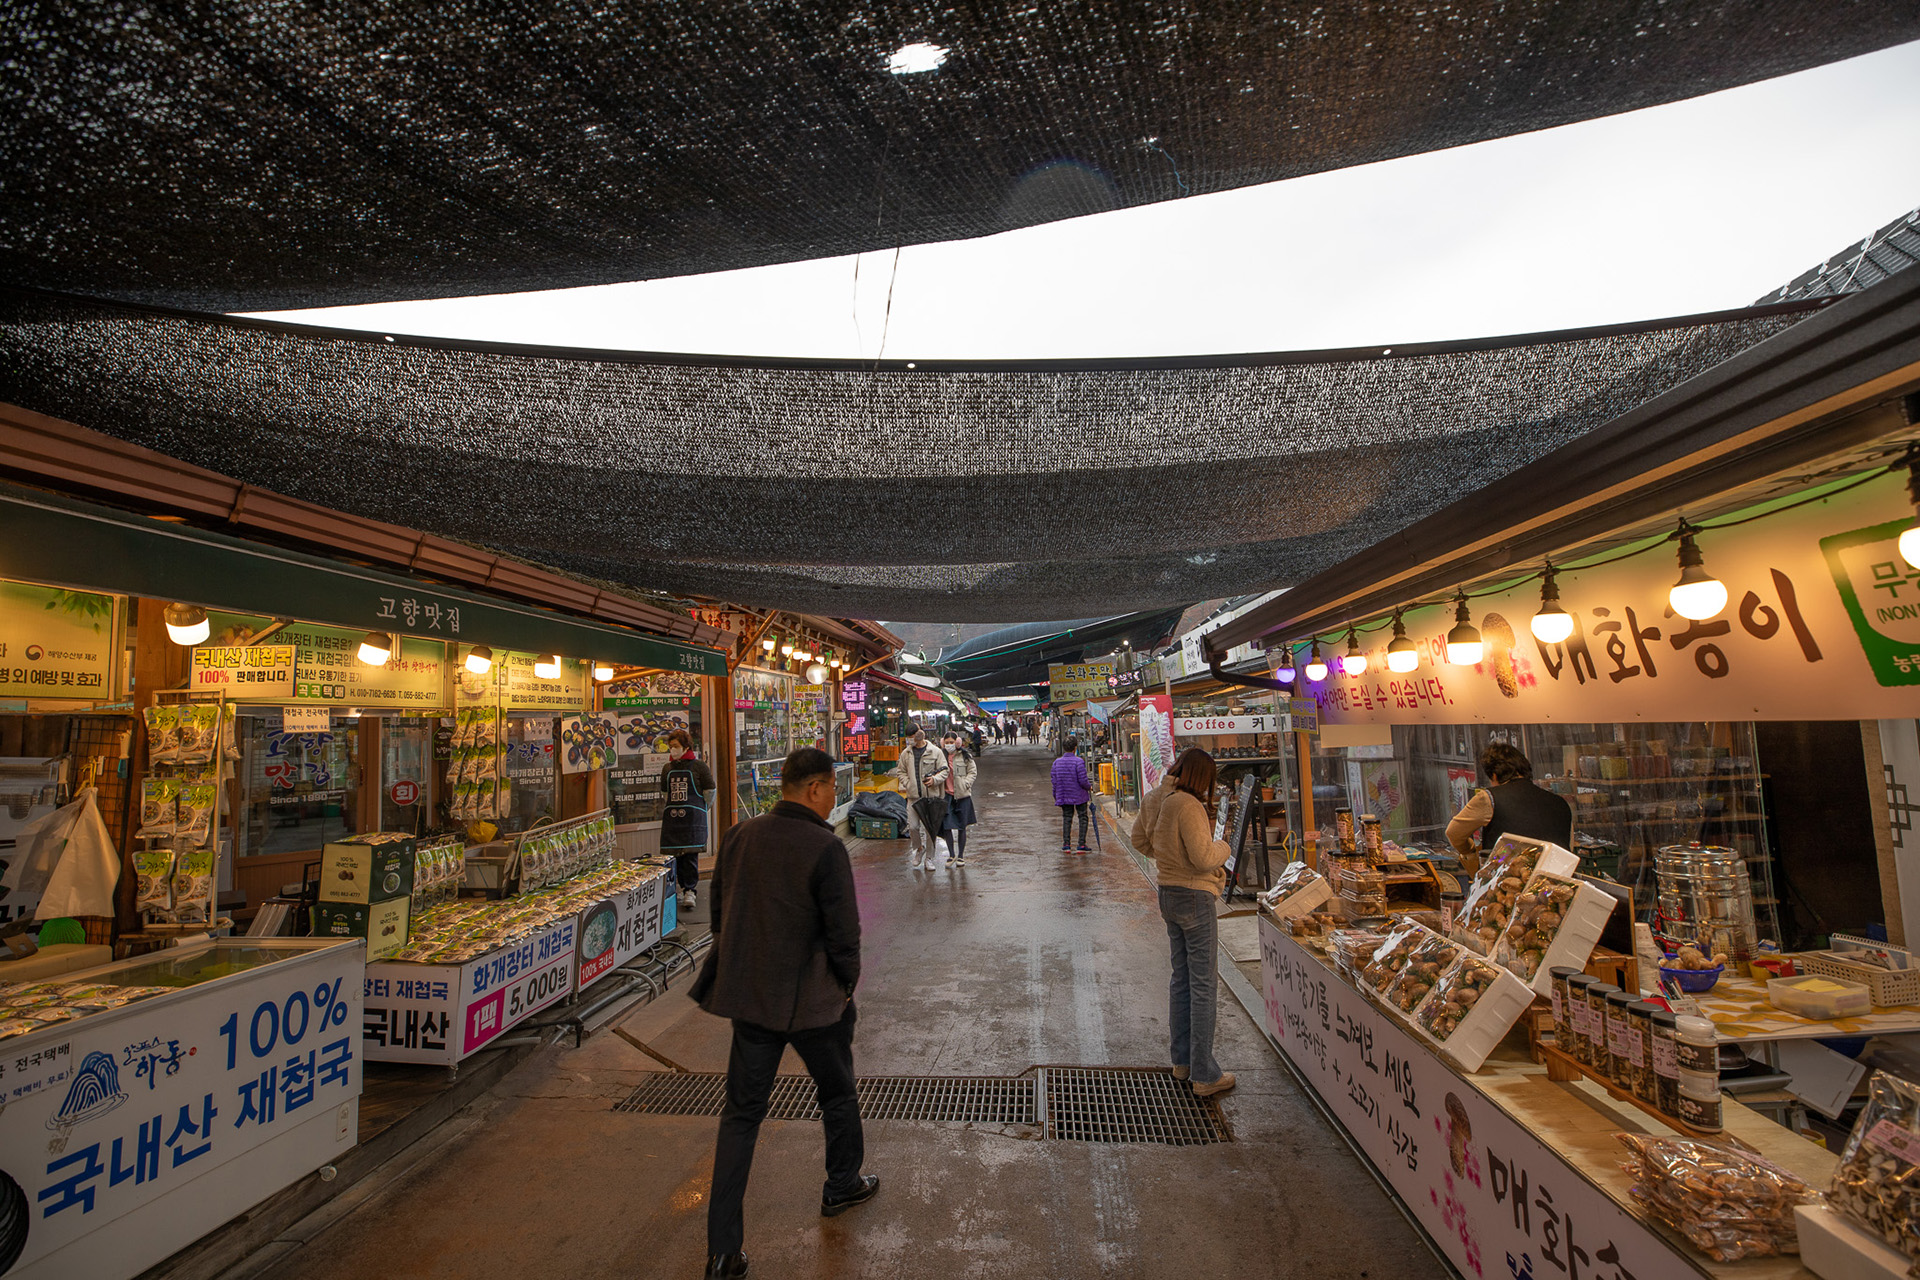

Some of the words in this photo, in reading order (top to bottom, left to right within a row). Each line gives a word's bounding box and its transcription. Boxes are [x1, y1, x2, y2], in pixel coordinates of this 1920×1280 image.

[376, 597, 461, 633] 고향맛집
[273, 631, 312, 647] 화개장터
[314, 635, 353, 651] 재첩국은?
[194, 648, 242, 670] 국내산
[244, 647, 292, 669] 재첩국
[679, 653, 705, 671] 고향맛집
[12, 668, 28, 684] 외
[30, 669, 59, 686] 예방
[60, 671, 75, 686] 및
[76, 672, 102, 687] 효과
[198, 670, 230, 684] 100%
[236, 669, 289, 684] 판매합니다.
[319, 669, 347, 682] 유통기한
[349, 672, 362, 683] 표기
[1065, 665, 1111, 681] 옥화주막
[1350, 683, 1374, 711] 드실
[1375, 683, 1388, 710] 수
[1390, 676, 1455, 710] 있습니다.
[284, 708, 303, 717] 재첩국
[1183, 719, 1236, 731] Coffee
[264, 760, 331, 788] 맛집
[519, 776, 541, 785] Since
[270, 795, 299, 805] Since
[302, 792, 329, 803] 1990
[395, 785, 414, 801] 회
[626, 879, 656, 911] 화개장터
[616, 903, 659, 952] 재첩국
[473, 948, 534, 994] 화개장터
[538, 924, 574, 960] 재첩국
[581, 962, 597, 980] 100%
[598, 950, 614, 971] 국내산
[396, 979, 449, 1001] 재첩국
[473, 999, 499, 1039] 1팩
[509, 965, 569, 1017] 5,000원
[1295, 961, 1331, 1031] 향기를
[219, 976, 349, 1072] 100%
[363, 1007, 450, 1051] 국내산
[15, 1042, 71, 1073] 전국택배
[135, 1040, 187, 1091] 하동
[13, 1080, 42, 1098] 택배비
[46, 1071, 70, 1086] 무료)
[37, 1094, 219, 1220] 국내산
[234, 1036, 354, 1130] 재첩국
[1387, 1115, 1419, 1173] 식감
